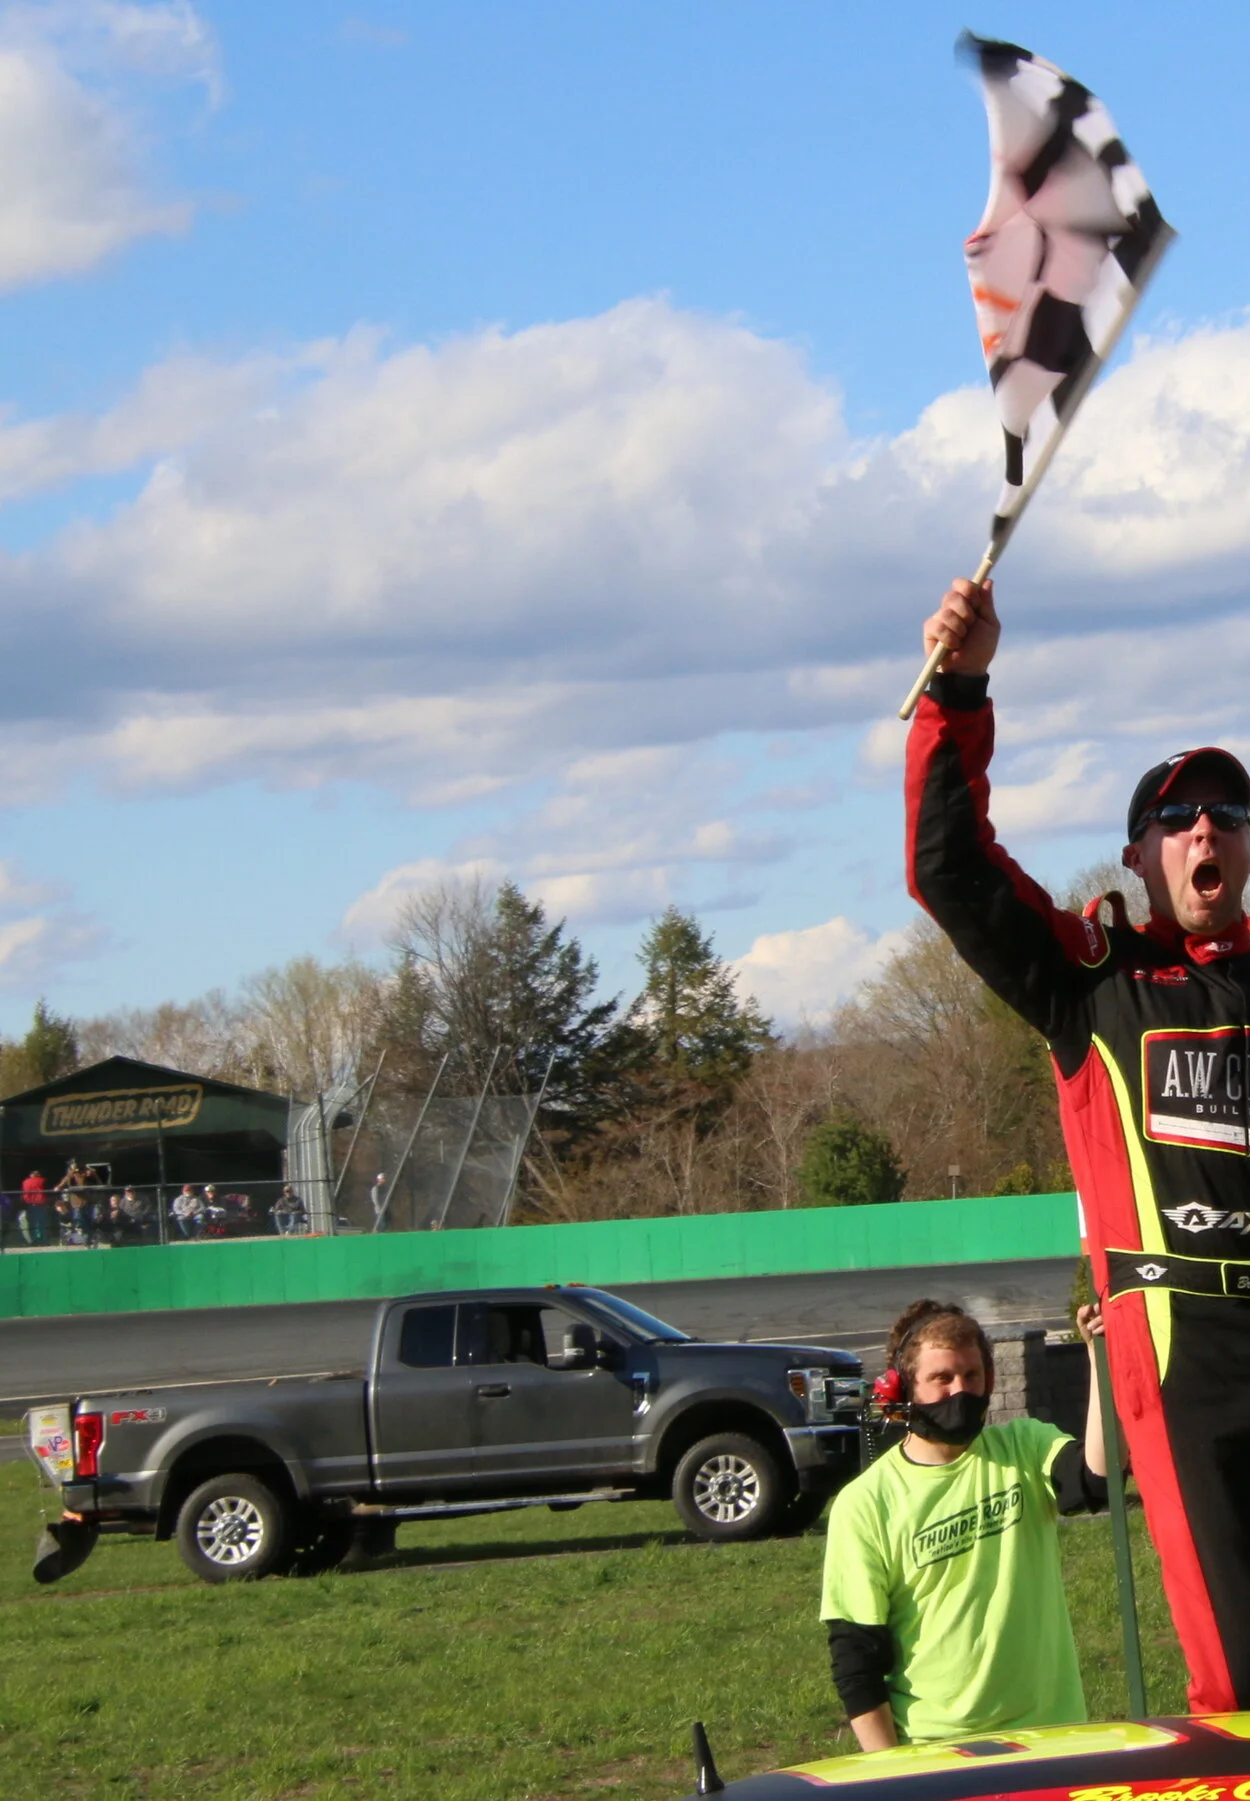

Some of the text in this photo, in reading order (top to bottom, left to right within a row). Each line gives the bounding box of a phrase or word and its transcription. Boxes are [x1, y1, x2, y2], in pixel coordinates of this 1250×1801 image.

[52, 1094, 193, 1128] THUNDER ROAD
[918, 1515, 979, 1553] THUNDE
[982, 1490, 1020, 1520] ROAD
